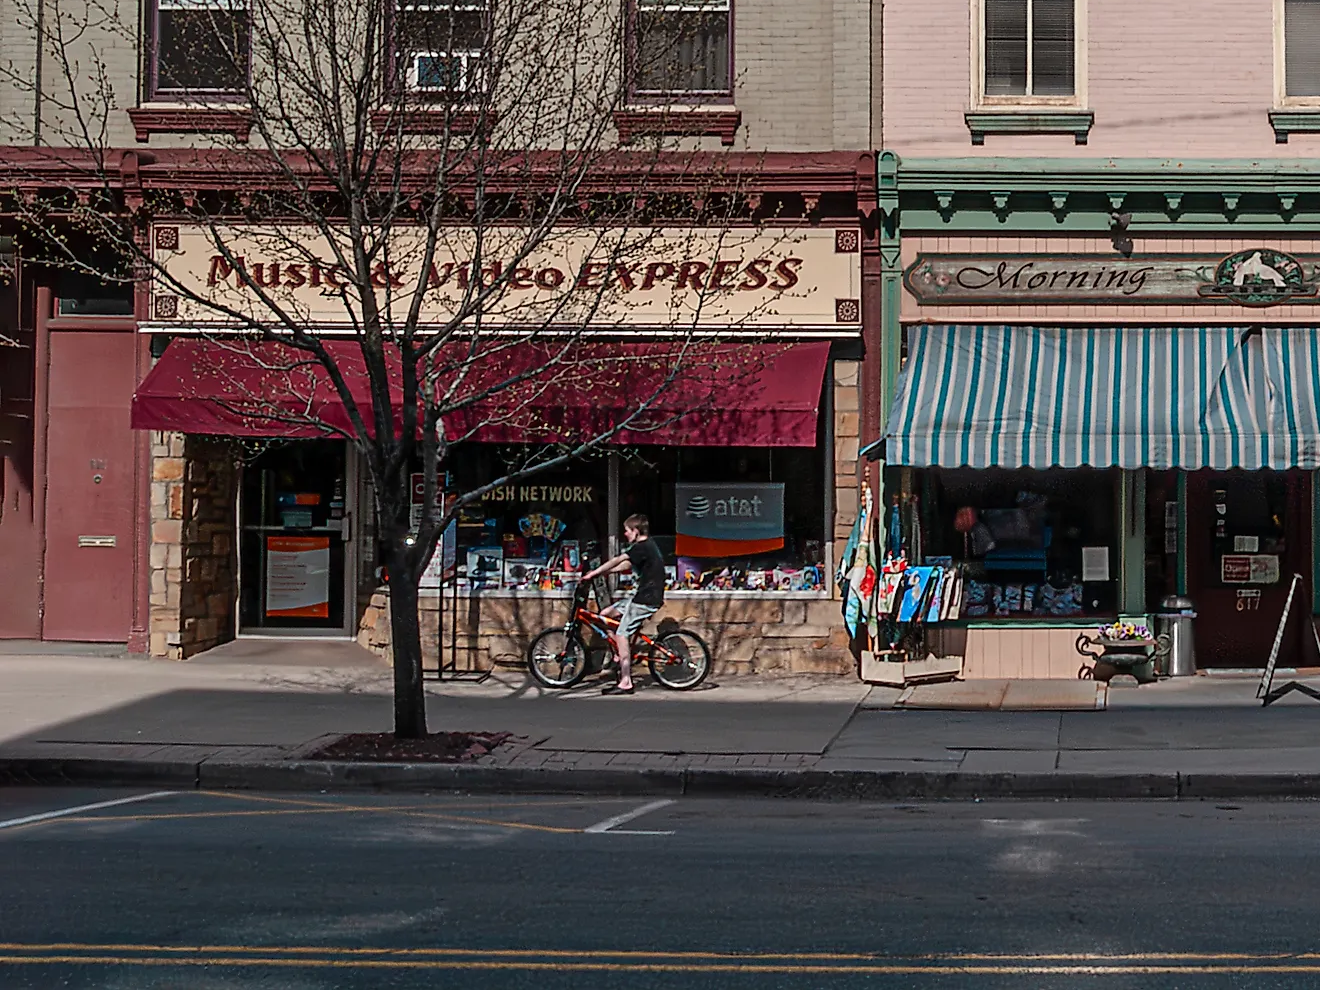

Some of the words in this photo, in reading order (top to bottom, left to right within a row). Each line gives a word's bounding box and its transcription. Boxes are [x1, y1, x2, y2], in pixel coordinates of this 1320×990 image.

[206, 255, 350, 289] Music
[575, 258, 803, 291] EXPRESS
[956, 261, 1154, 295] Morning
[520, 485, 592, 502] NETWORK
[1236, 597, 1260, 611] 617
